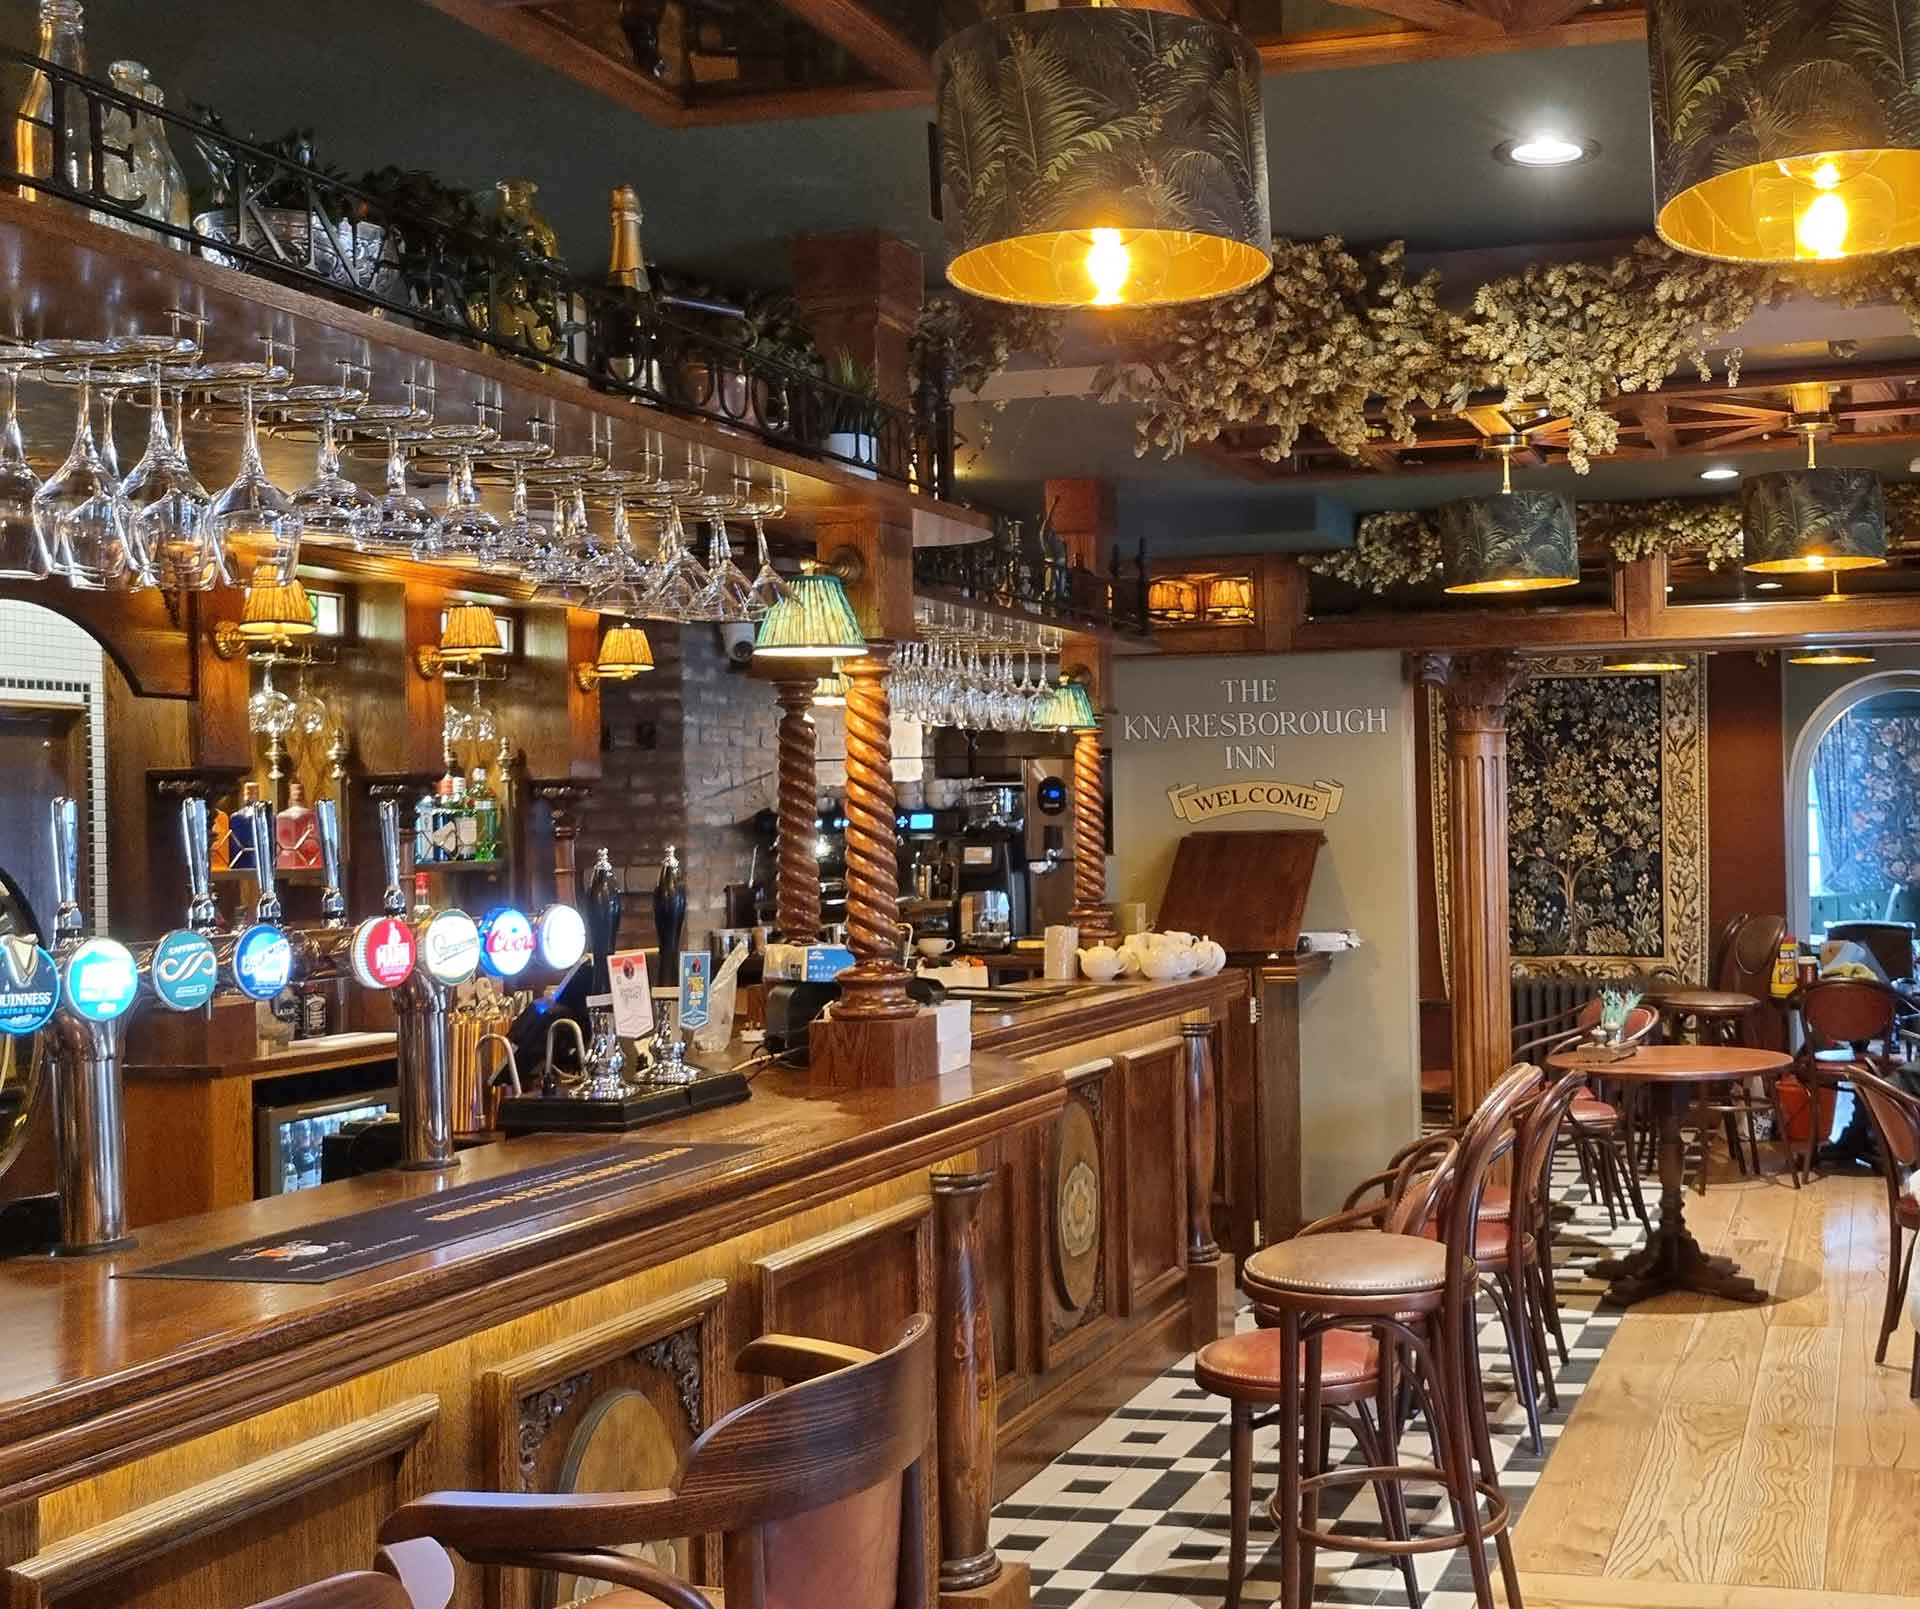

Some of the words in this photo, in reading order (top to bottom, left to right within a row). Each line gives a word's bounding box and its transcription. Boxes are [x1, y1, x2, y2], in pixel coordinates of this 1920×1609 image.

[1220, 678, 1279, 704] THE
[1122, 707, 1389, 742] KNARESBOROUGH
[1224, 744, 1278, 770] INN
[1193, 786, 1319, 813] WELCOME
[0, 991, 52, 1007] UINNESS
